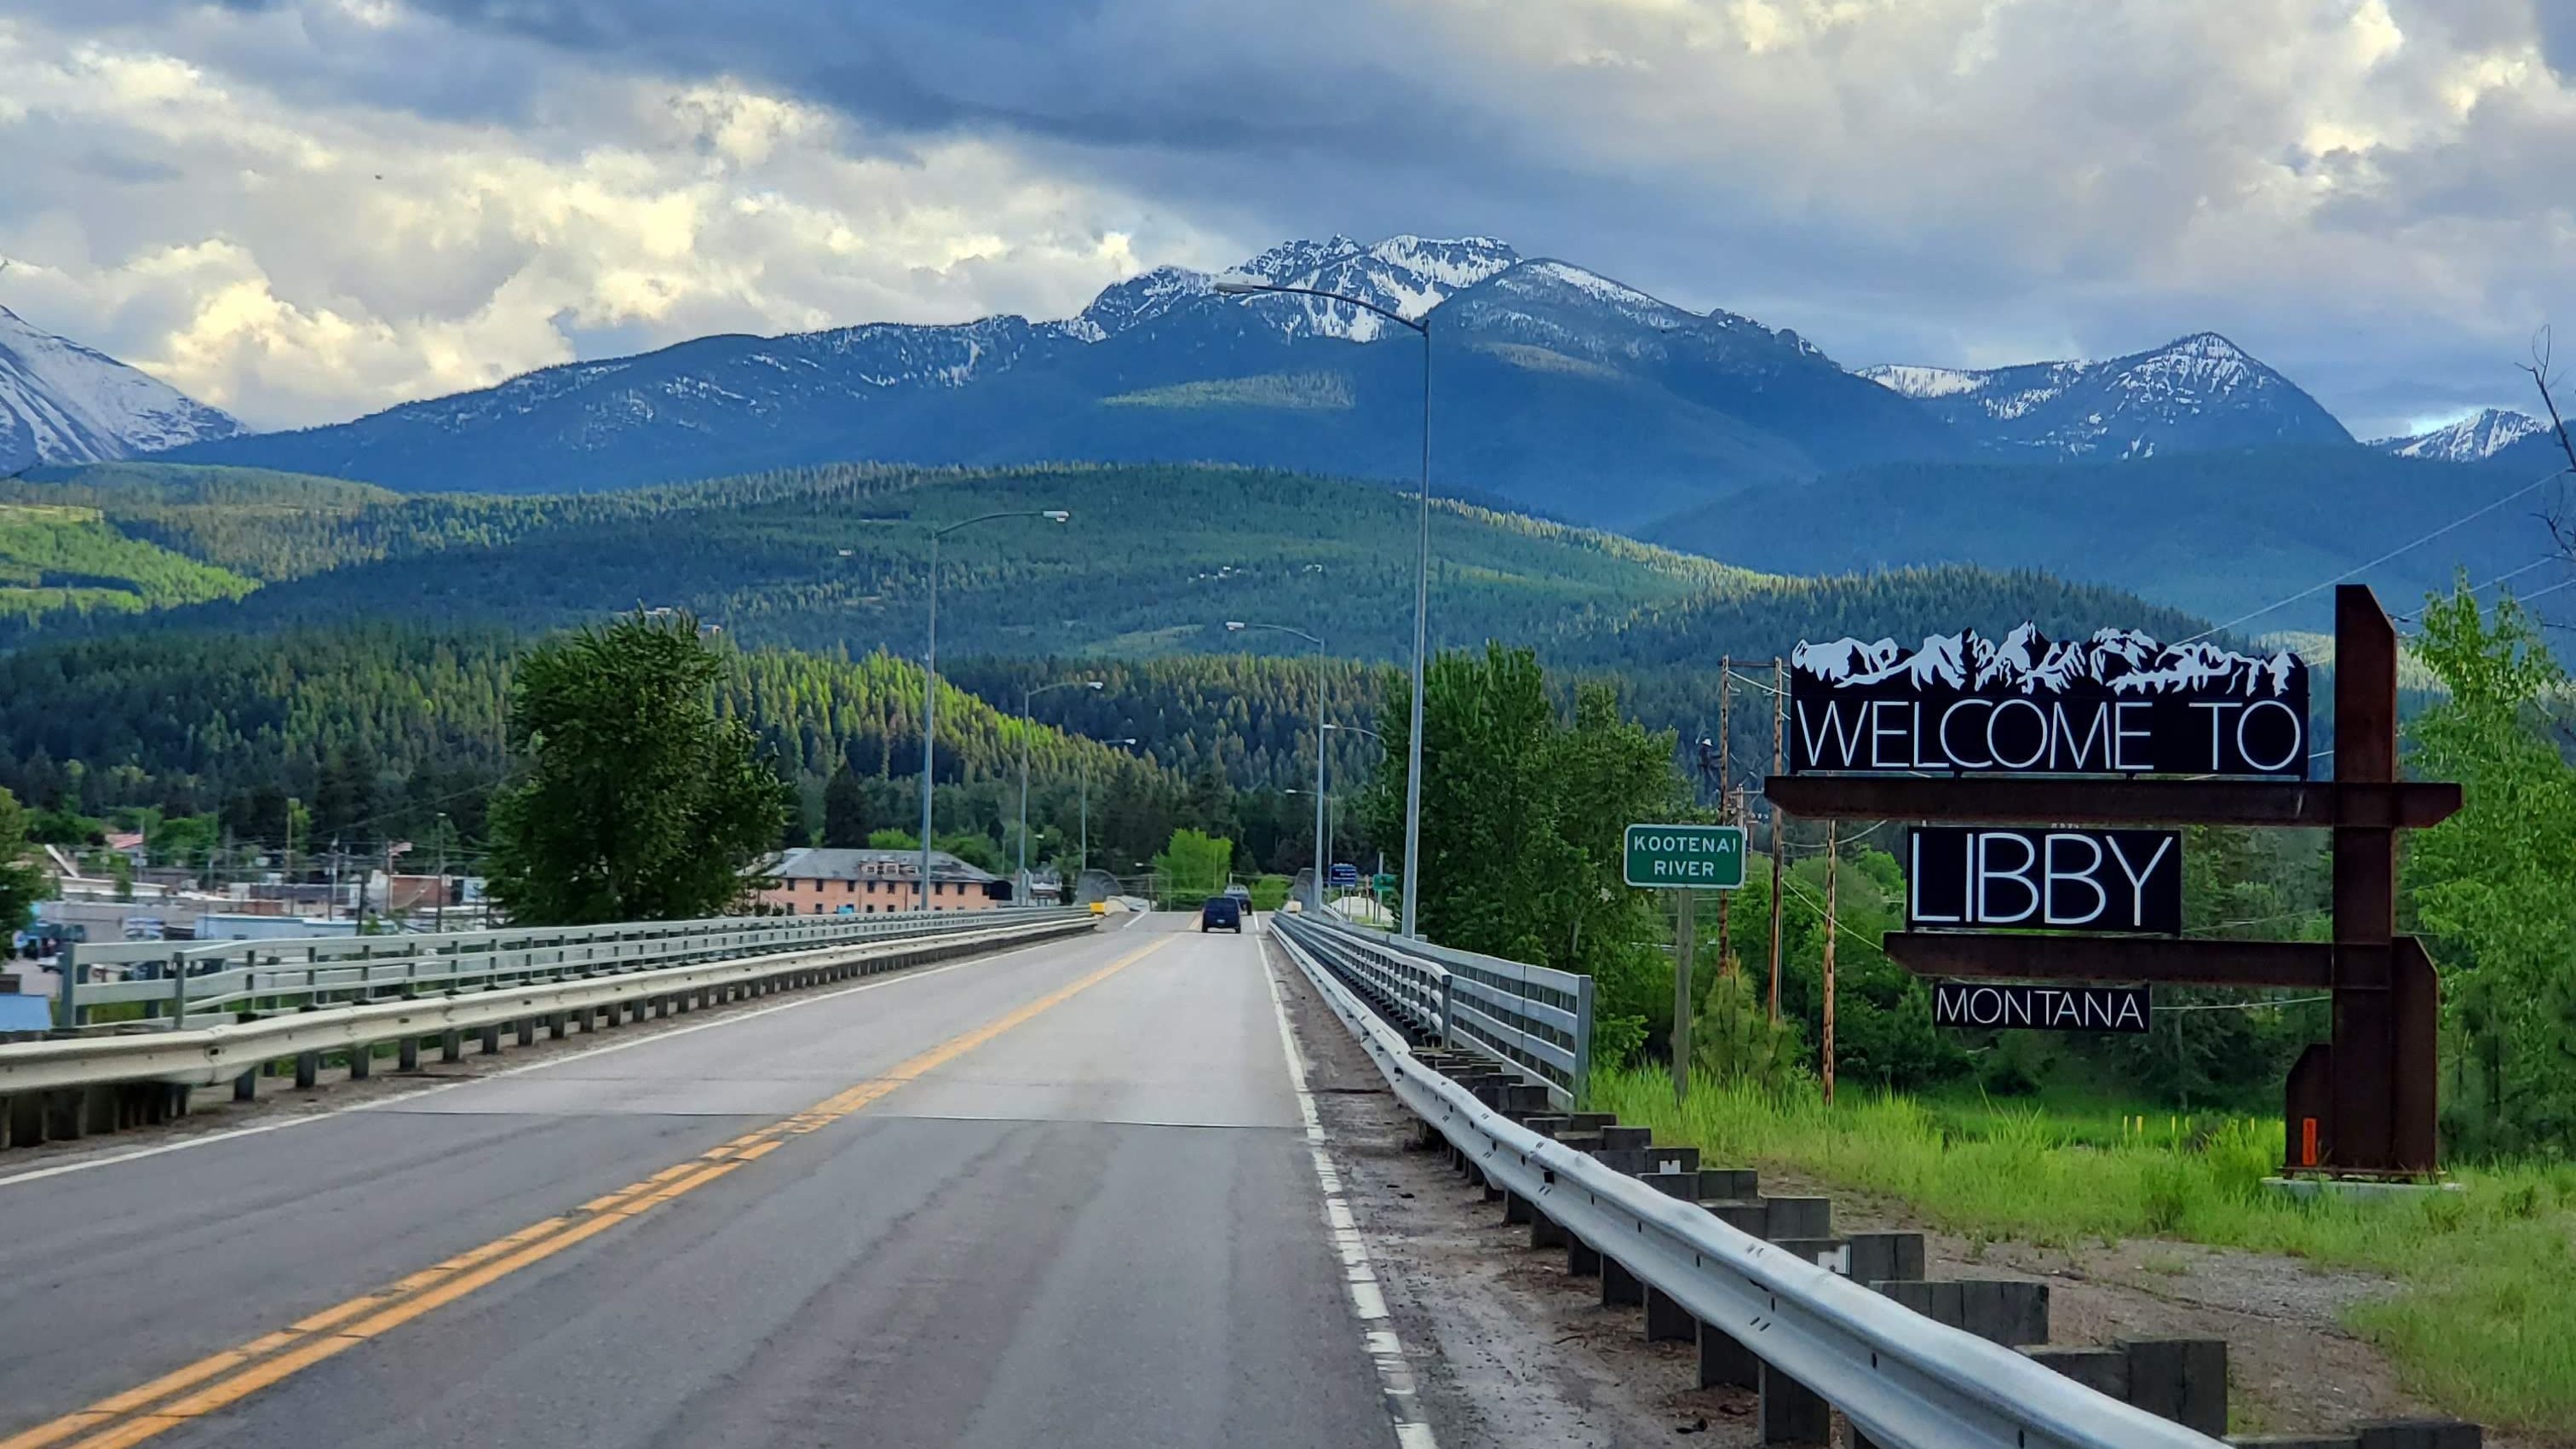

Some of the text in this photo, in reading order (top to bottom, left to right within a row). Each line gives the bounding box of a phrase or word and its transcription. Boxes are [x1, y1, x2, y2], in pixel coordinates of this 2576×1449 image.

[1797, 699, 2302, 771] WELCOME TO
[1634, 836, 1737, 853] KOOTENAI
[1653, 860, 1715, 877] RIVER
[1911, 831, 2174, 926] LIBBY
[1936, 987, 2144, 1029] MONTANA
